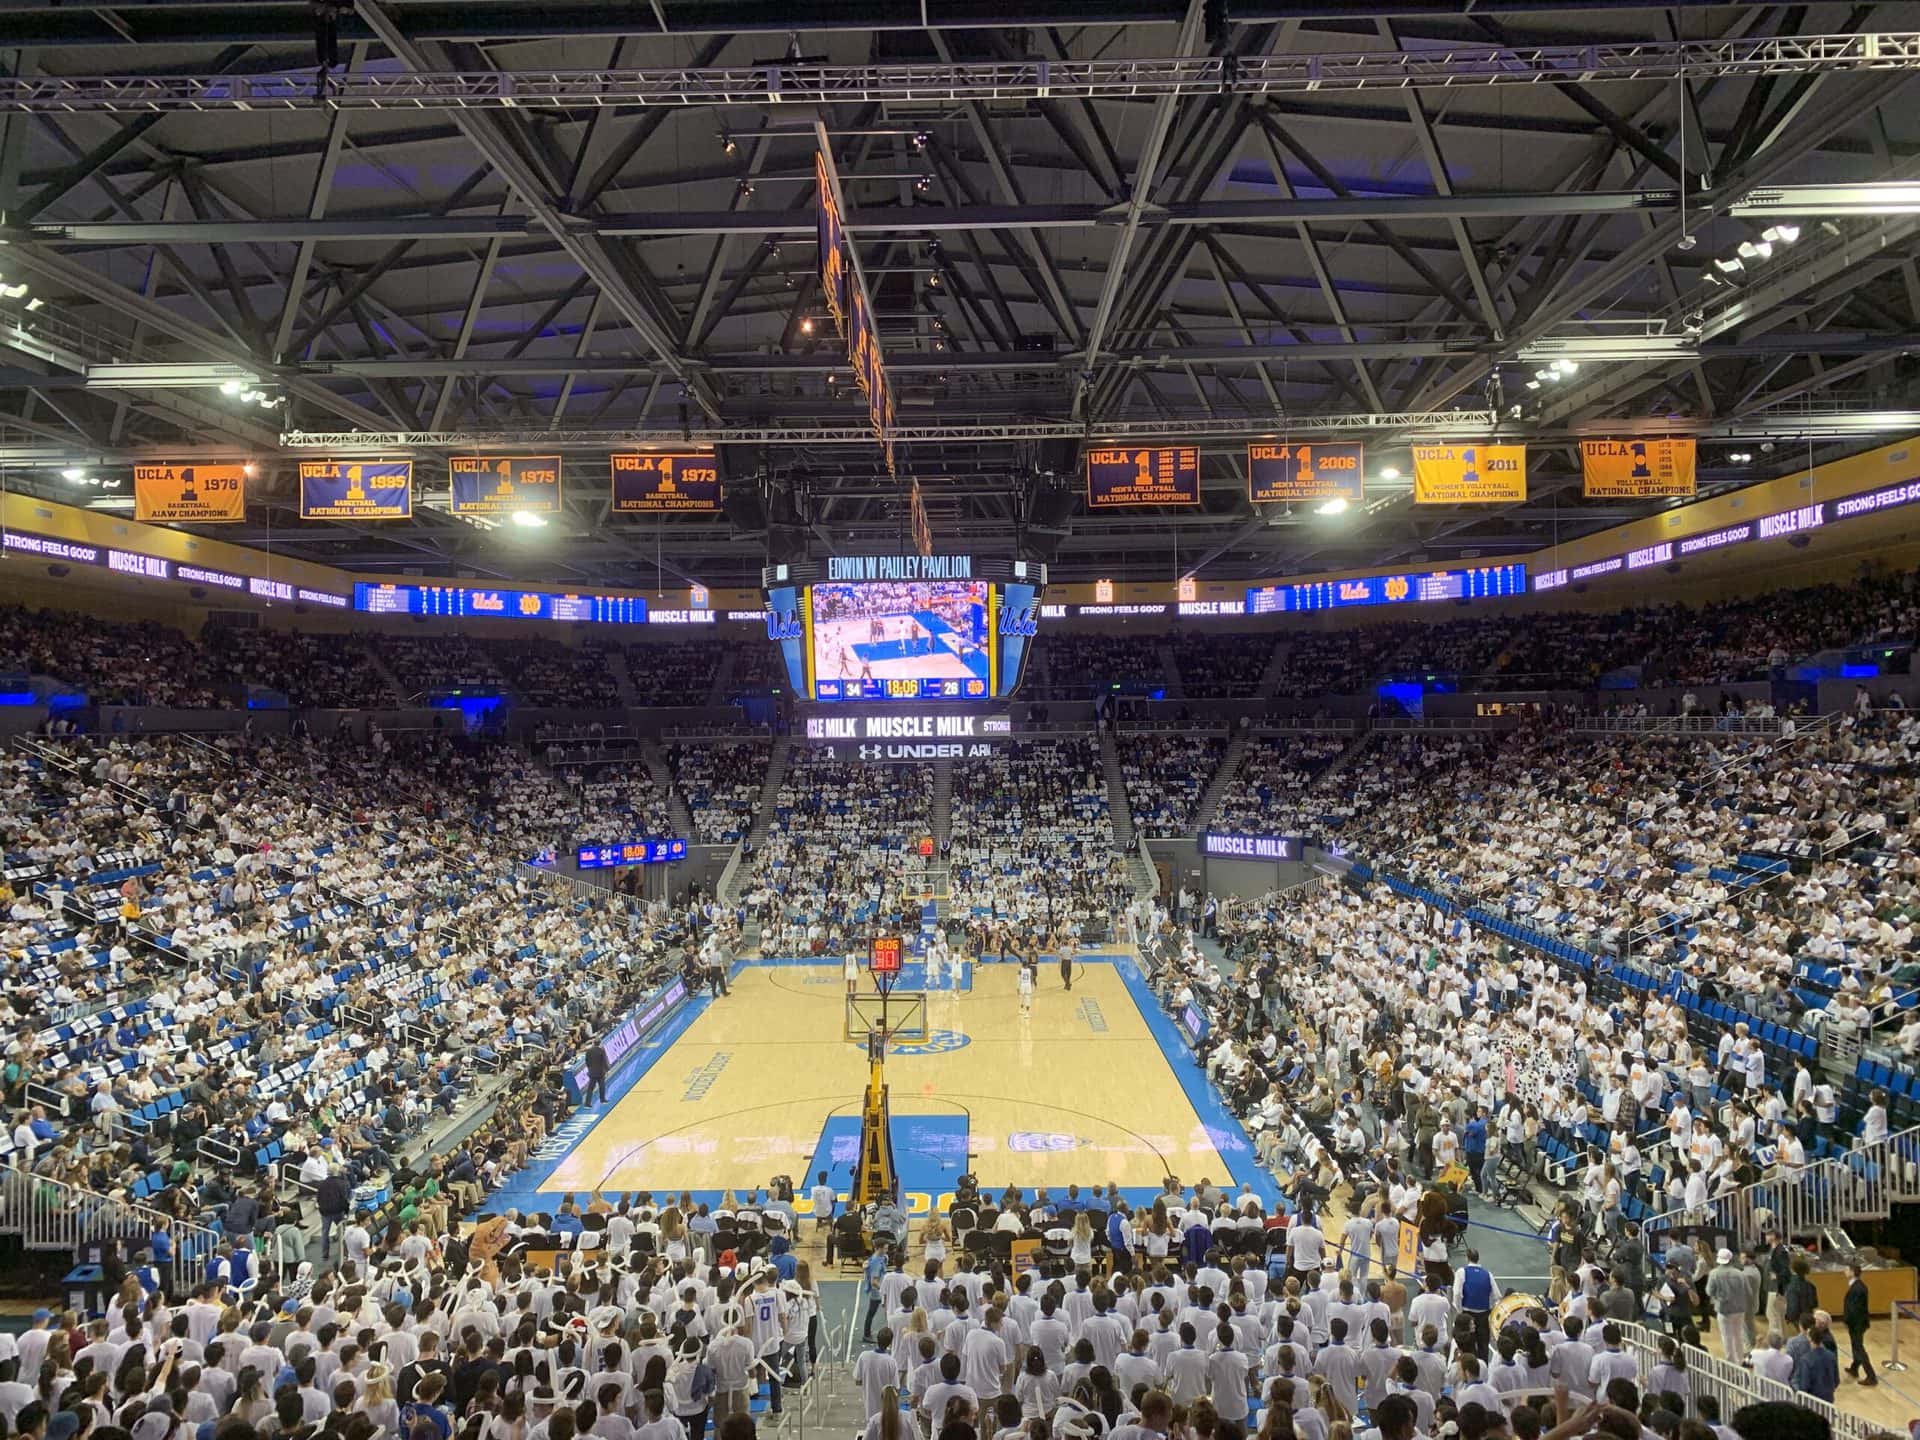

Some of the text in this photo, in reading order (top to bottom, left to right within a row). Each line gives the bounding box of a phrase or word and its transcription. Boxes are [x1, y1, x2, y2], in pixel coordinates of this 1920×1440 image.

[1252, 447, 1290, 459] UCLA
[1418, 449, 1455, 460] UCLA
[1586, 443, 1629, 456] UCLA
[615, 458, 654, 470] UCLA
[1091, 452, 1129, 464] UCLA
[1297, 446, 1315, 480] 1
[1462, 449, 1479, 481] 1
[1488, 459, 1518, 471] 2011
[1631, 443, 1651, 477] 1
[303, 466, 341, 478] UCLA
[453, 460, 491, 472] UCLA
[1135, 451, 1153, 485] 1
[136, 469, 174, 480] UCLA
[497, 460, 514, 494] 1
[520, 470, 555, 484] 1975
[658, 458, 676, 492] 1
[681, 469, 716, 482] 1973
[181, 468, 197, 501] 1
[204, 479, 238, 490] 1978
[347, 465, 365, 499] 1
[370, 475, 406, 489] 1995
[1097, 493, 1191, 502] NATIONAL CHAMPIONS
[1257, 489, 1301, 498] NATIONAL
[1423, 491, 1467, 499] NATIONAL
[1589, 486, 1691, 495] NATIONAL CHAMPIONS
[621, 500, 713, 508] NATIONAL CHAMPIONS
[1838, 495, 1876, 516] STRONG
[1876, 489, 1907, 506] FEELS
[309, 506, 402, 515] NATIONAL CHAMPIONS
[1760, 504, 1824, 538] MUSCLE MILK
[1681, 527, 1749, 553] STRONG FEELS GOOD
[3, 534, 94, 561] STRONG FEELS GOOD
[1628, 543, 1673, 569] MUSCLE MILK
[108, 550, 168, 578] MUSCLE MILK
[828, 556, 971, 579] EDWIN W PAULEY PAVILION
[1573, 567, 1591, 578] STRONG
[1606, 558, 1622, 570] GOOD
[178, 566, 242, 588] STRONG FEELS GOOD
[250, 577, 293, 600] MUSCLE MILK
[299, 589, 318, 602] STRONG
[1041, 605, 1067, 617] MILK
[1080, 605, 1164, 614] STRONG FEELS GOOD
[1179, 601, 1244, 615] MUSCLE MILK
[649, 610, 715, 623] MUSCLE MILK
[728, 611, 761, 620] STRONG
[847, 682, 860, 696] 34
[886, 680, 918, 694] 18:06
[944, 681, 958, 695] 26
[825, 717, 856, 738] MILK
[866, 716, 973, 738] MUSCLE MILK
[887, 744, 963, 759] UNDER
[1207, 836, 1287, 857] MUSCLE MILK
[600, 849, 612, 860] 34
[875, 940, 898, 950] 18:06
[761, 1306, 770, 1321] 0
